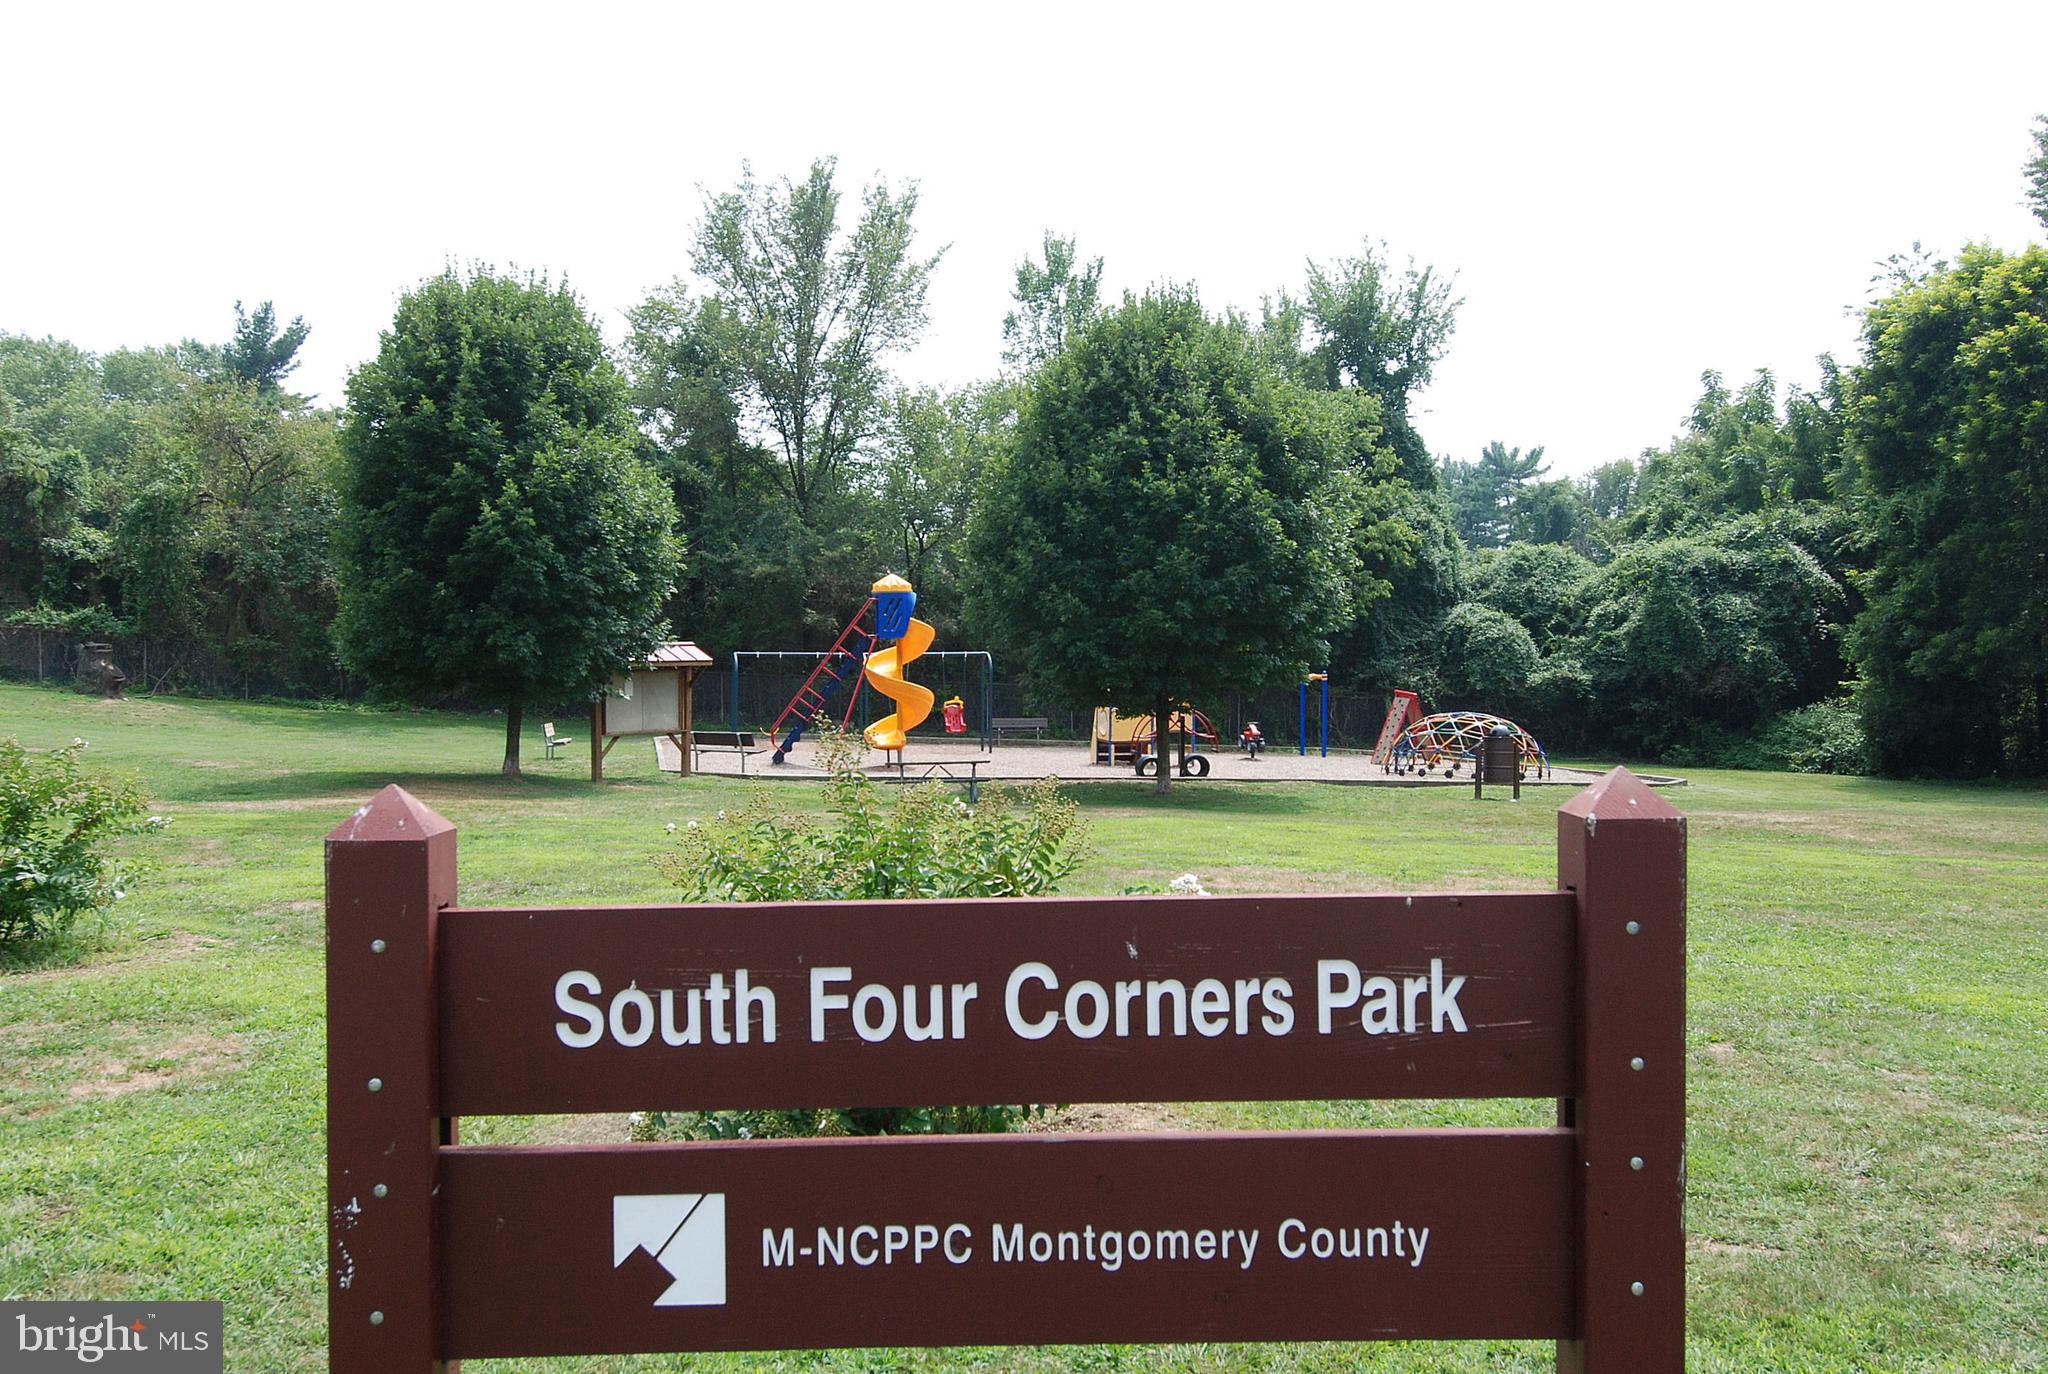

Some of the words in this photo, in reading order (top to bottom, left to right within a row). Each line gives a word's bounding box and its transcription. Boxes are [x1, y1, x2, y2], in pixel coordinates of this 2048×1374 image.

[555, 968, 777, 1048] South
[810, 966, 979, 1042] Four
[1004, 962, 1296, 1040] Corners
[1317, 958, 1469, 1035] Park
[762, 1223, 972, 1267] M-NCPPC
[992, 1223, 1259, 1271] Montgomery
[1278, 1218, 1431, 1268] County
